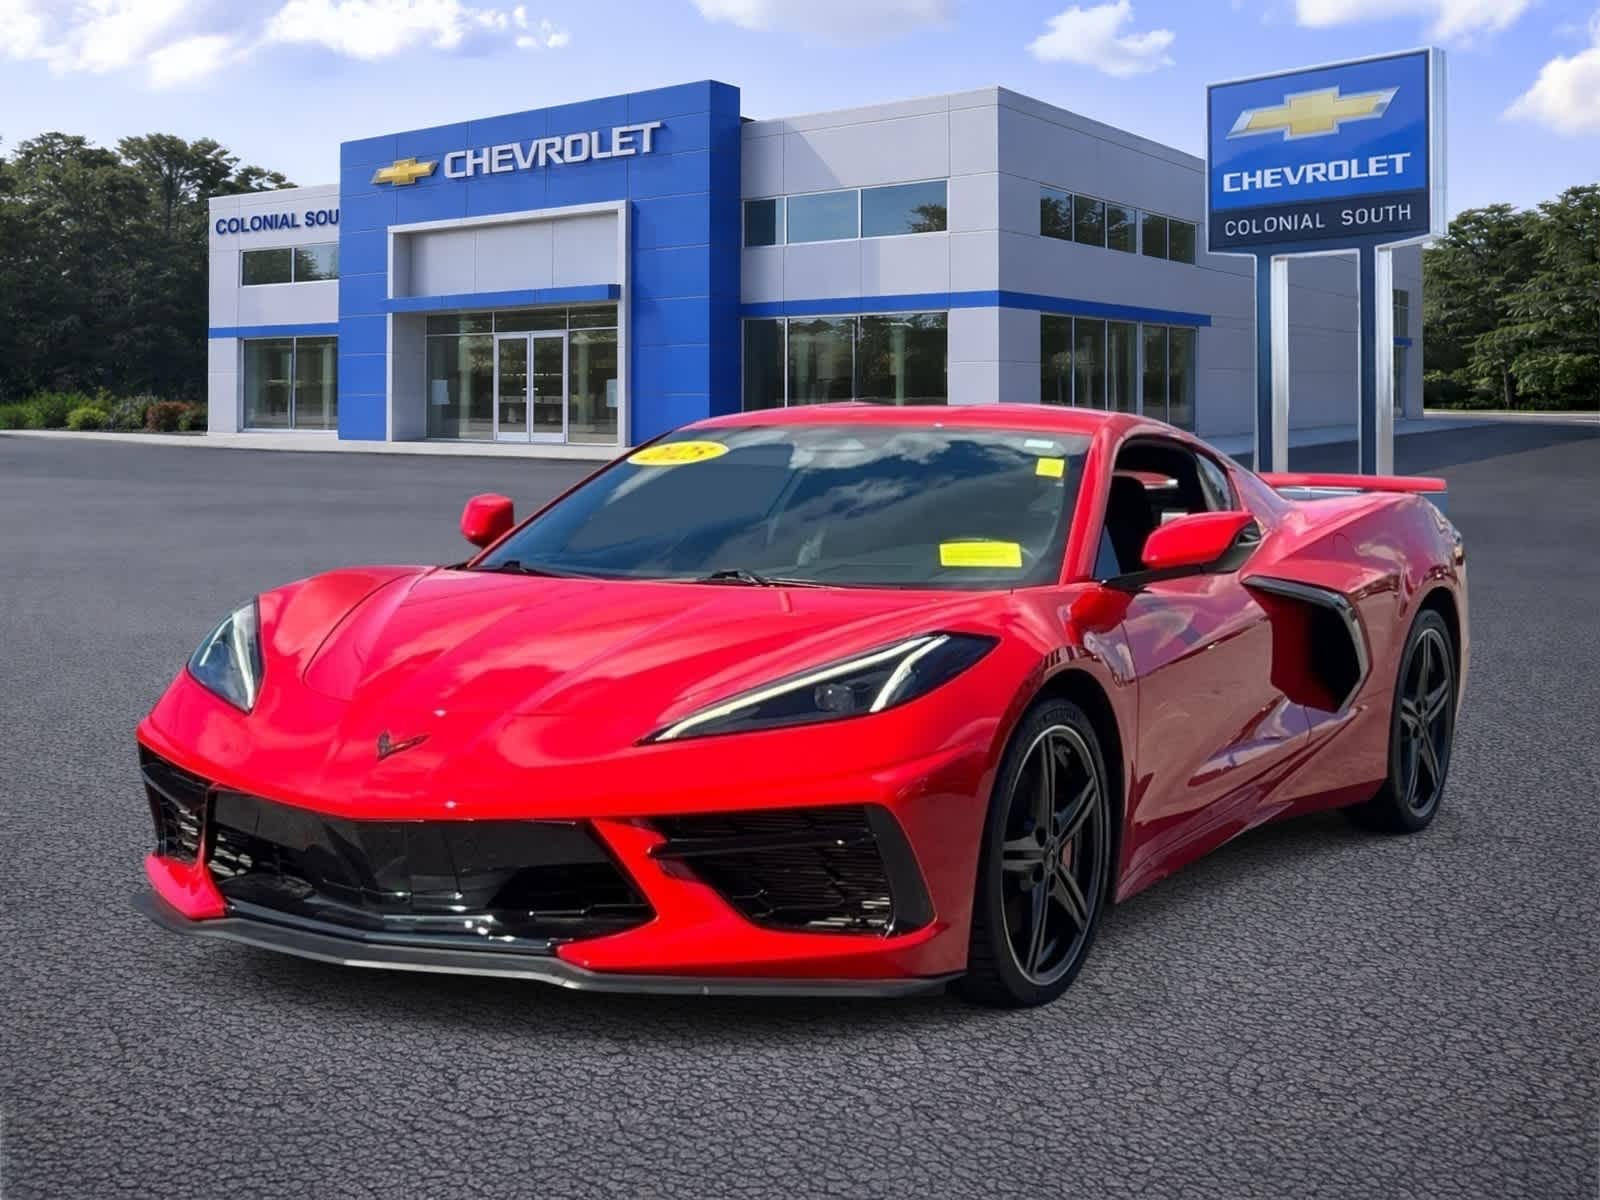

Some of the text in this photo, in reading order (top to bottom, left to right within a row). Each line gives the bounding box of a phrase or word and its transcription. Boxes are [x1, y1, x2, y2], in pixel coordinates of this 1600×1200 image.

[444, 121, 661, 178] CHEVROLET
[1222, 152, 1412, 192] CHEVROLET
[215, 213, 300, 234] COLONIAL
[1224, 204, 1412, 236] COLONIAL SOUTH
